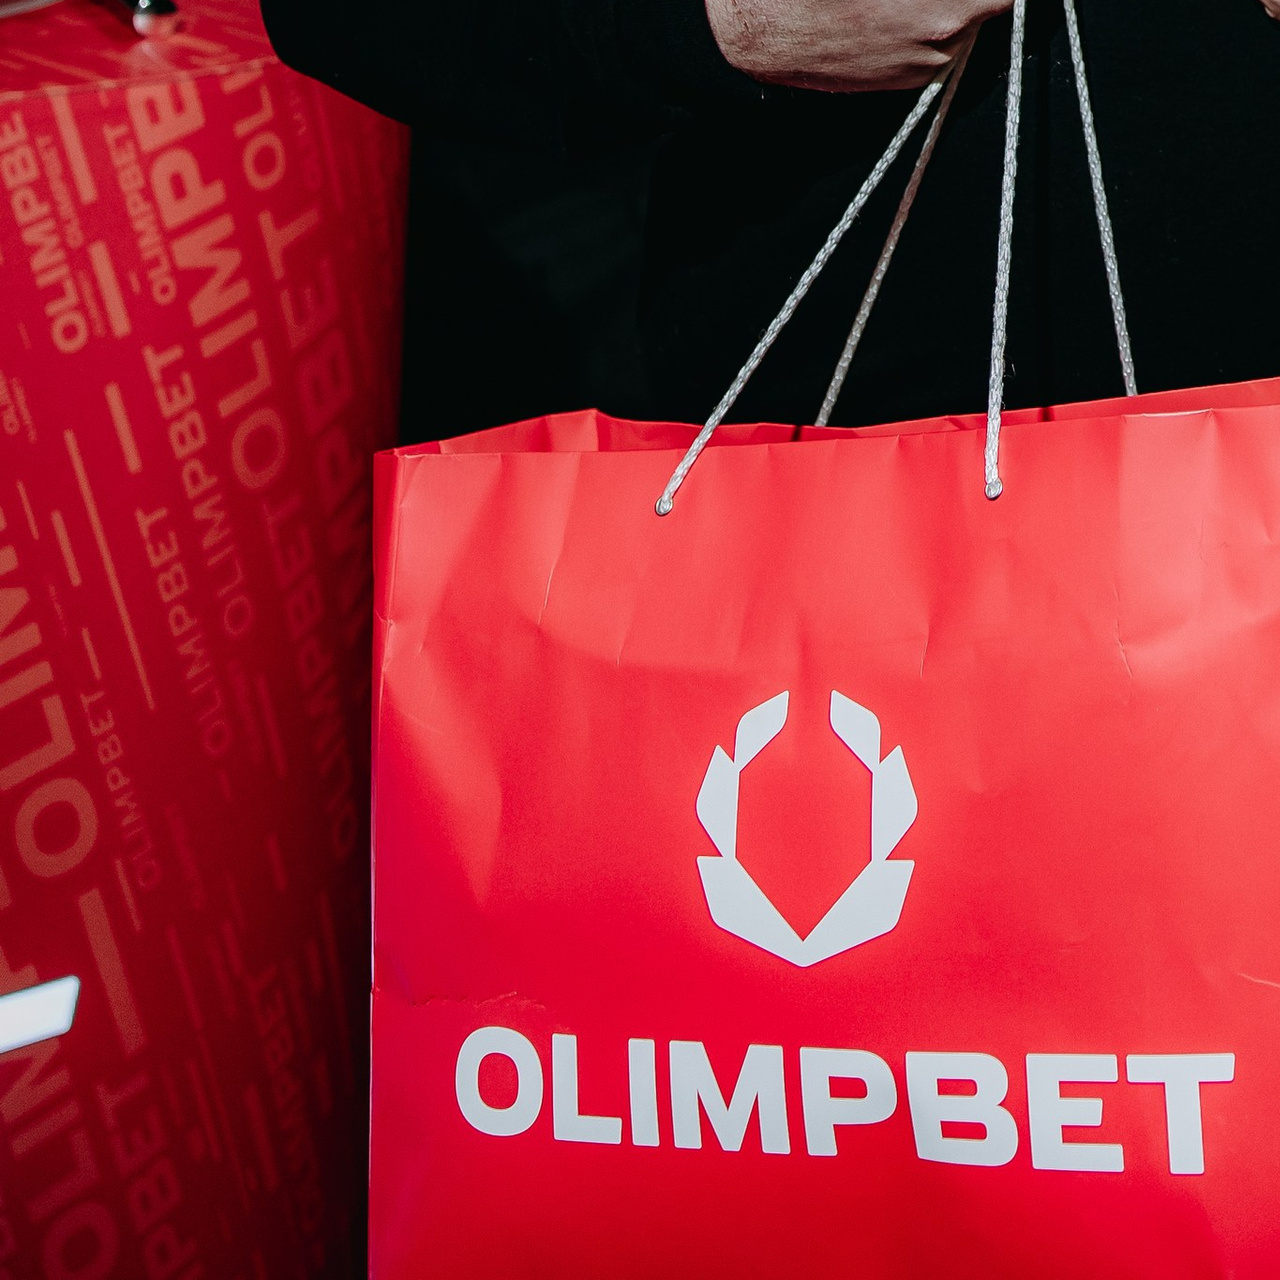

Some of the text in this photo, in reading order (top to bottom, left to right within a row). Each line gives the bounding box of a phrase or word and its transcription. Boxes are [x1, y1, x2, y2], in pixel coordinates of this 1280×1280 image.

[103, 121, 177, 307] OLIMPBET
[141, 344, 255, 640] OLIMPBET
[135, 505, 231, 757] OLIMPBET
[79, 690, 161, 891] OLIMPBET
[455, 1026, 1236, 1175] OLIMPBET
